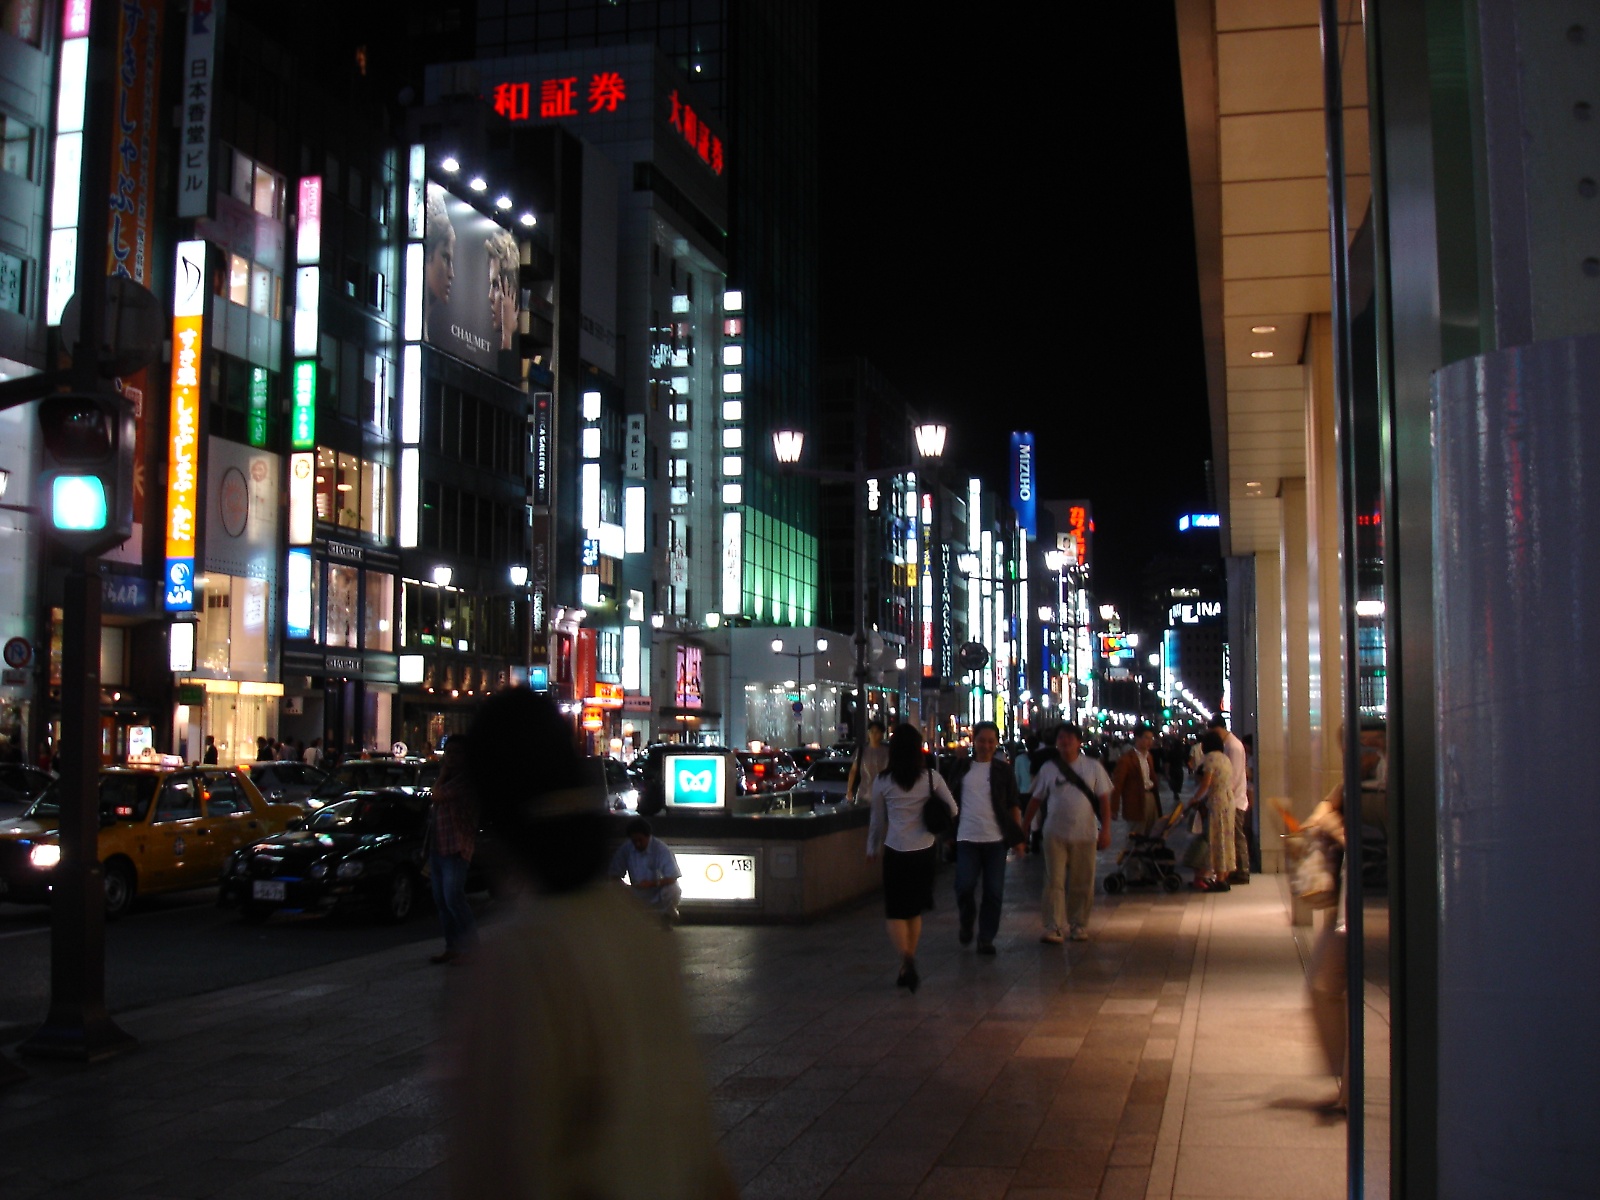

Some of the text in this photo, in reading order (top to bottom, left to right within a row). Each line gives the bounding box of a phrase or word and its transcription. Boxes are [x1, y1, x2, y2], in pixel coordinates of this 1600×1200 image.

[185, 58, 207, 192] 日本香堂ビル
[451, 324, 490, 352] CHAUMET
[538, 436, 546, 471] GALLERY
[1019, 444, 1031, 501] MIZUHO
